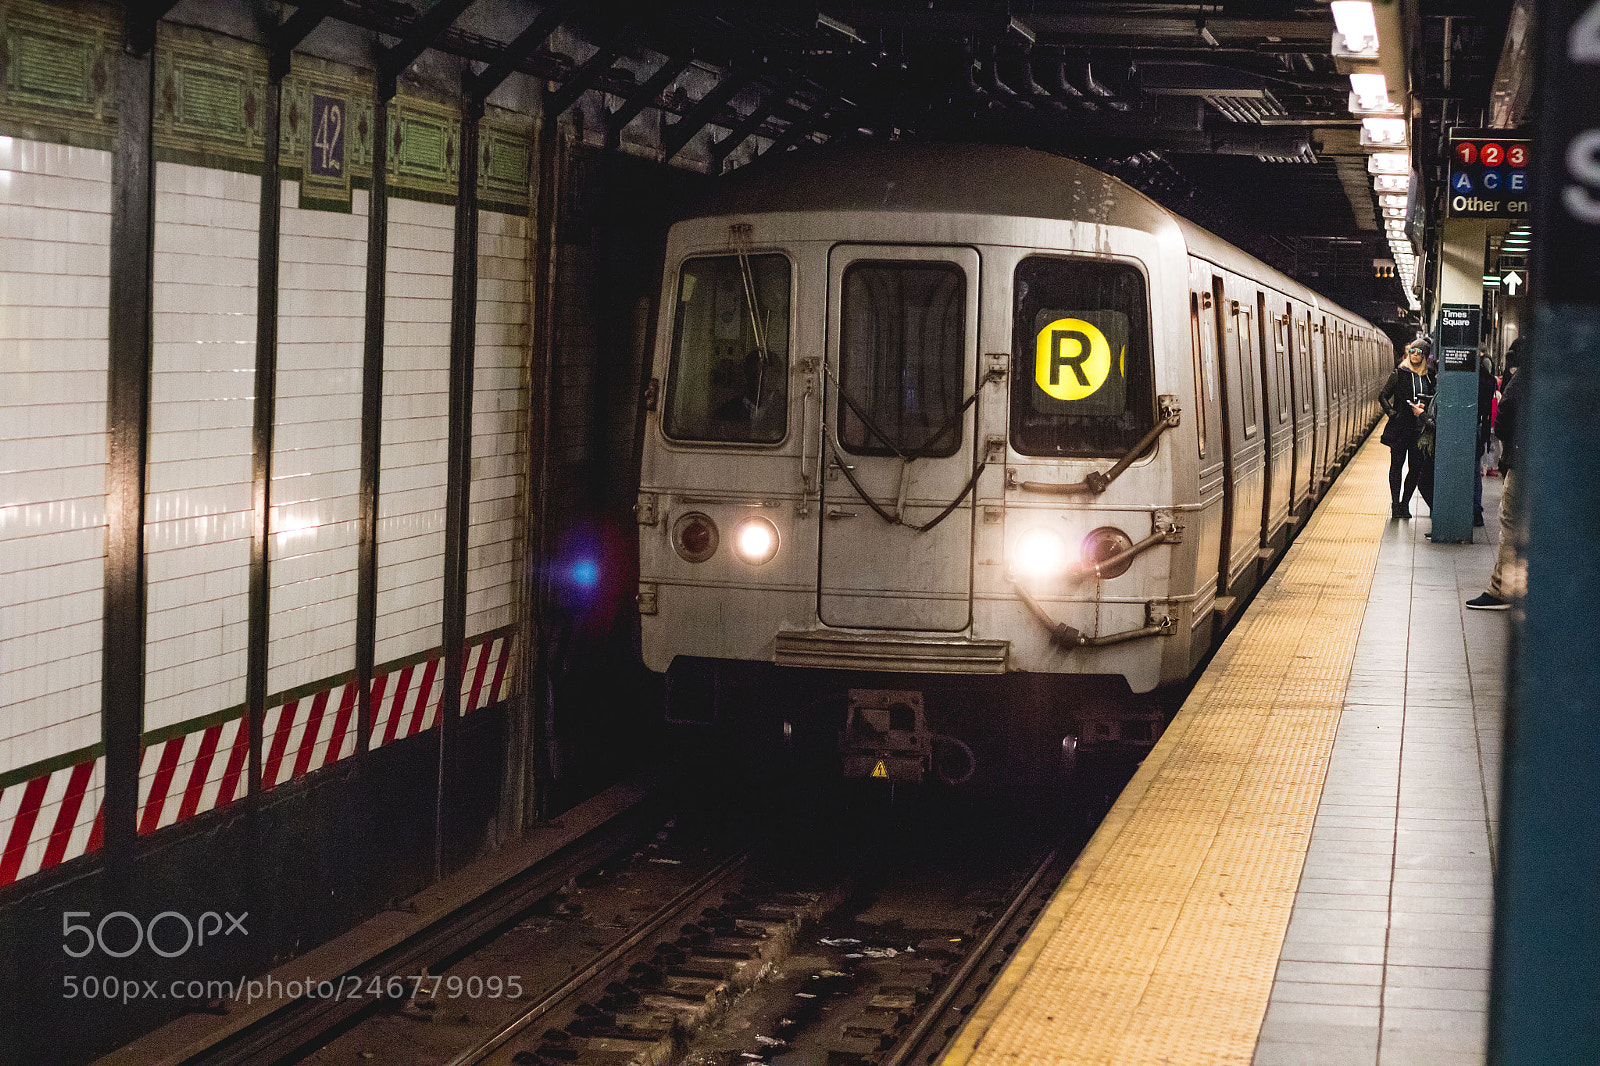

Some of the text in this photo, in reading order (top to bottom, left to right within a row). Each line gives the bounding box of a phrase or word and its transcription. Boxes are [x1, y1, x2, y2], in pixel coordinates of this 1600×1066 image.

[314, 105, 340, 169] 42
[1461, 148, 1524, 163] 1 2 3
[1457, 174, 1524, 189] A C E
[1453, 196, 1499, 211] Other
[1442, 310, 1467, 318] Times
[1442, 318, 1470, 326] Square
[1050, 330, 1091, 386] R
